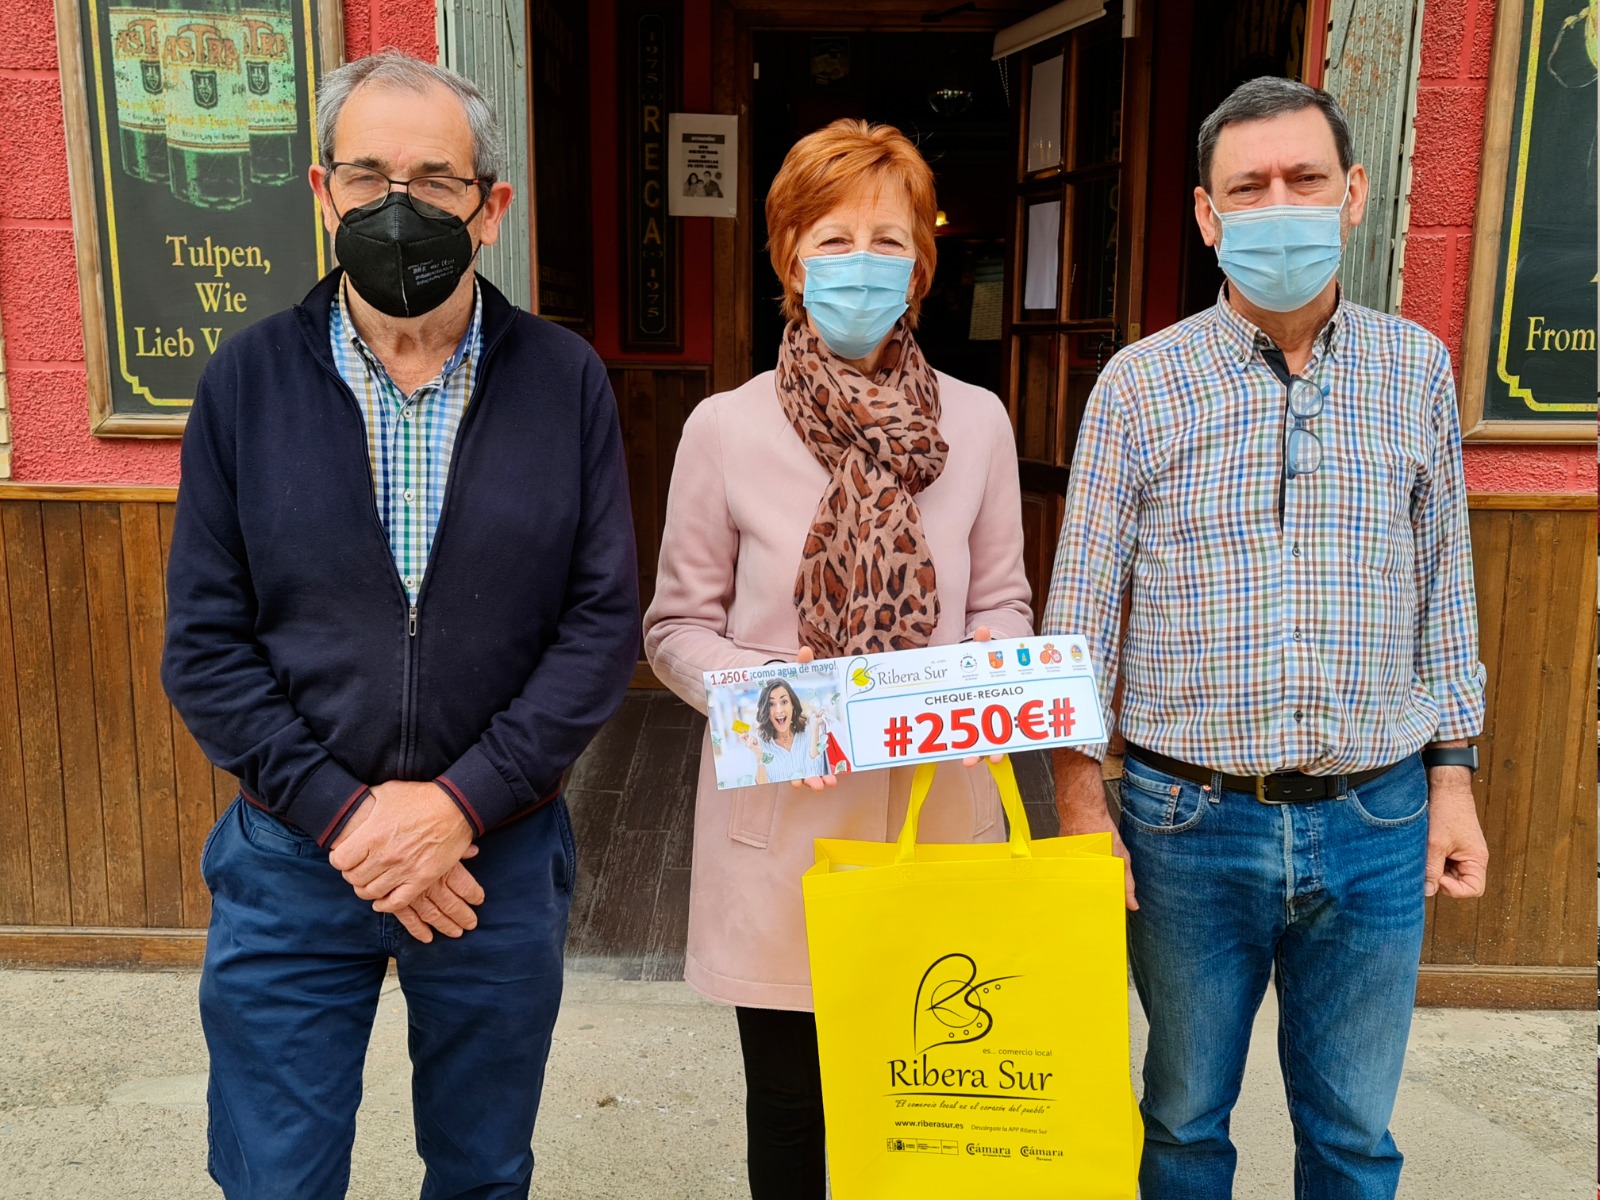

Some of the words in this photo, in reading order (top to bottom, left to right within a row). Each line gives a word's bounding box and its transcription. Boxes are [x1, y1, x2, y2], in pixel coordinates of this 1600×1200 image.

[162, 23, 242, 75] ASTRA
[642, 104, 661, 245] RECA
[165, 234, 271, 278] Tulpen,
[195, 281, 248, 313] Wie
[134, 326, 195, 358] Lieb
[200, 327, 223, 356] V
[1525, 315, 1596, 352] From
[710, 671, 740, 686] 1.250
[741, 670, 749, 682] €
[749, 670, 776, 681] ¡como
[777, 667, 797, 678] agua
[799, 664, 810, 674] de
[811, 660, 837, 673] mayo!
[877, 667, 921, 686] Ribera
[924, 665, 948, 681] Sur
[924, 685, 1024, 706] CHEQUE-REGALO
[883, 696, 1076, 758] #250€#
[998, 1048, 1034, 1056] comercio
[1034, 1049, 1053, 1057] local
[887, 1053, 989, 1088] Ribera
[998, 1059, 1053, 1091] Sur
[939, 1100, 956, 1109] local
[969, 1102, 977, 1110] el
[1008, 1104, 1020, 1113] del
[894, 1119, 964, 1130] www.riberasur.es
